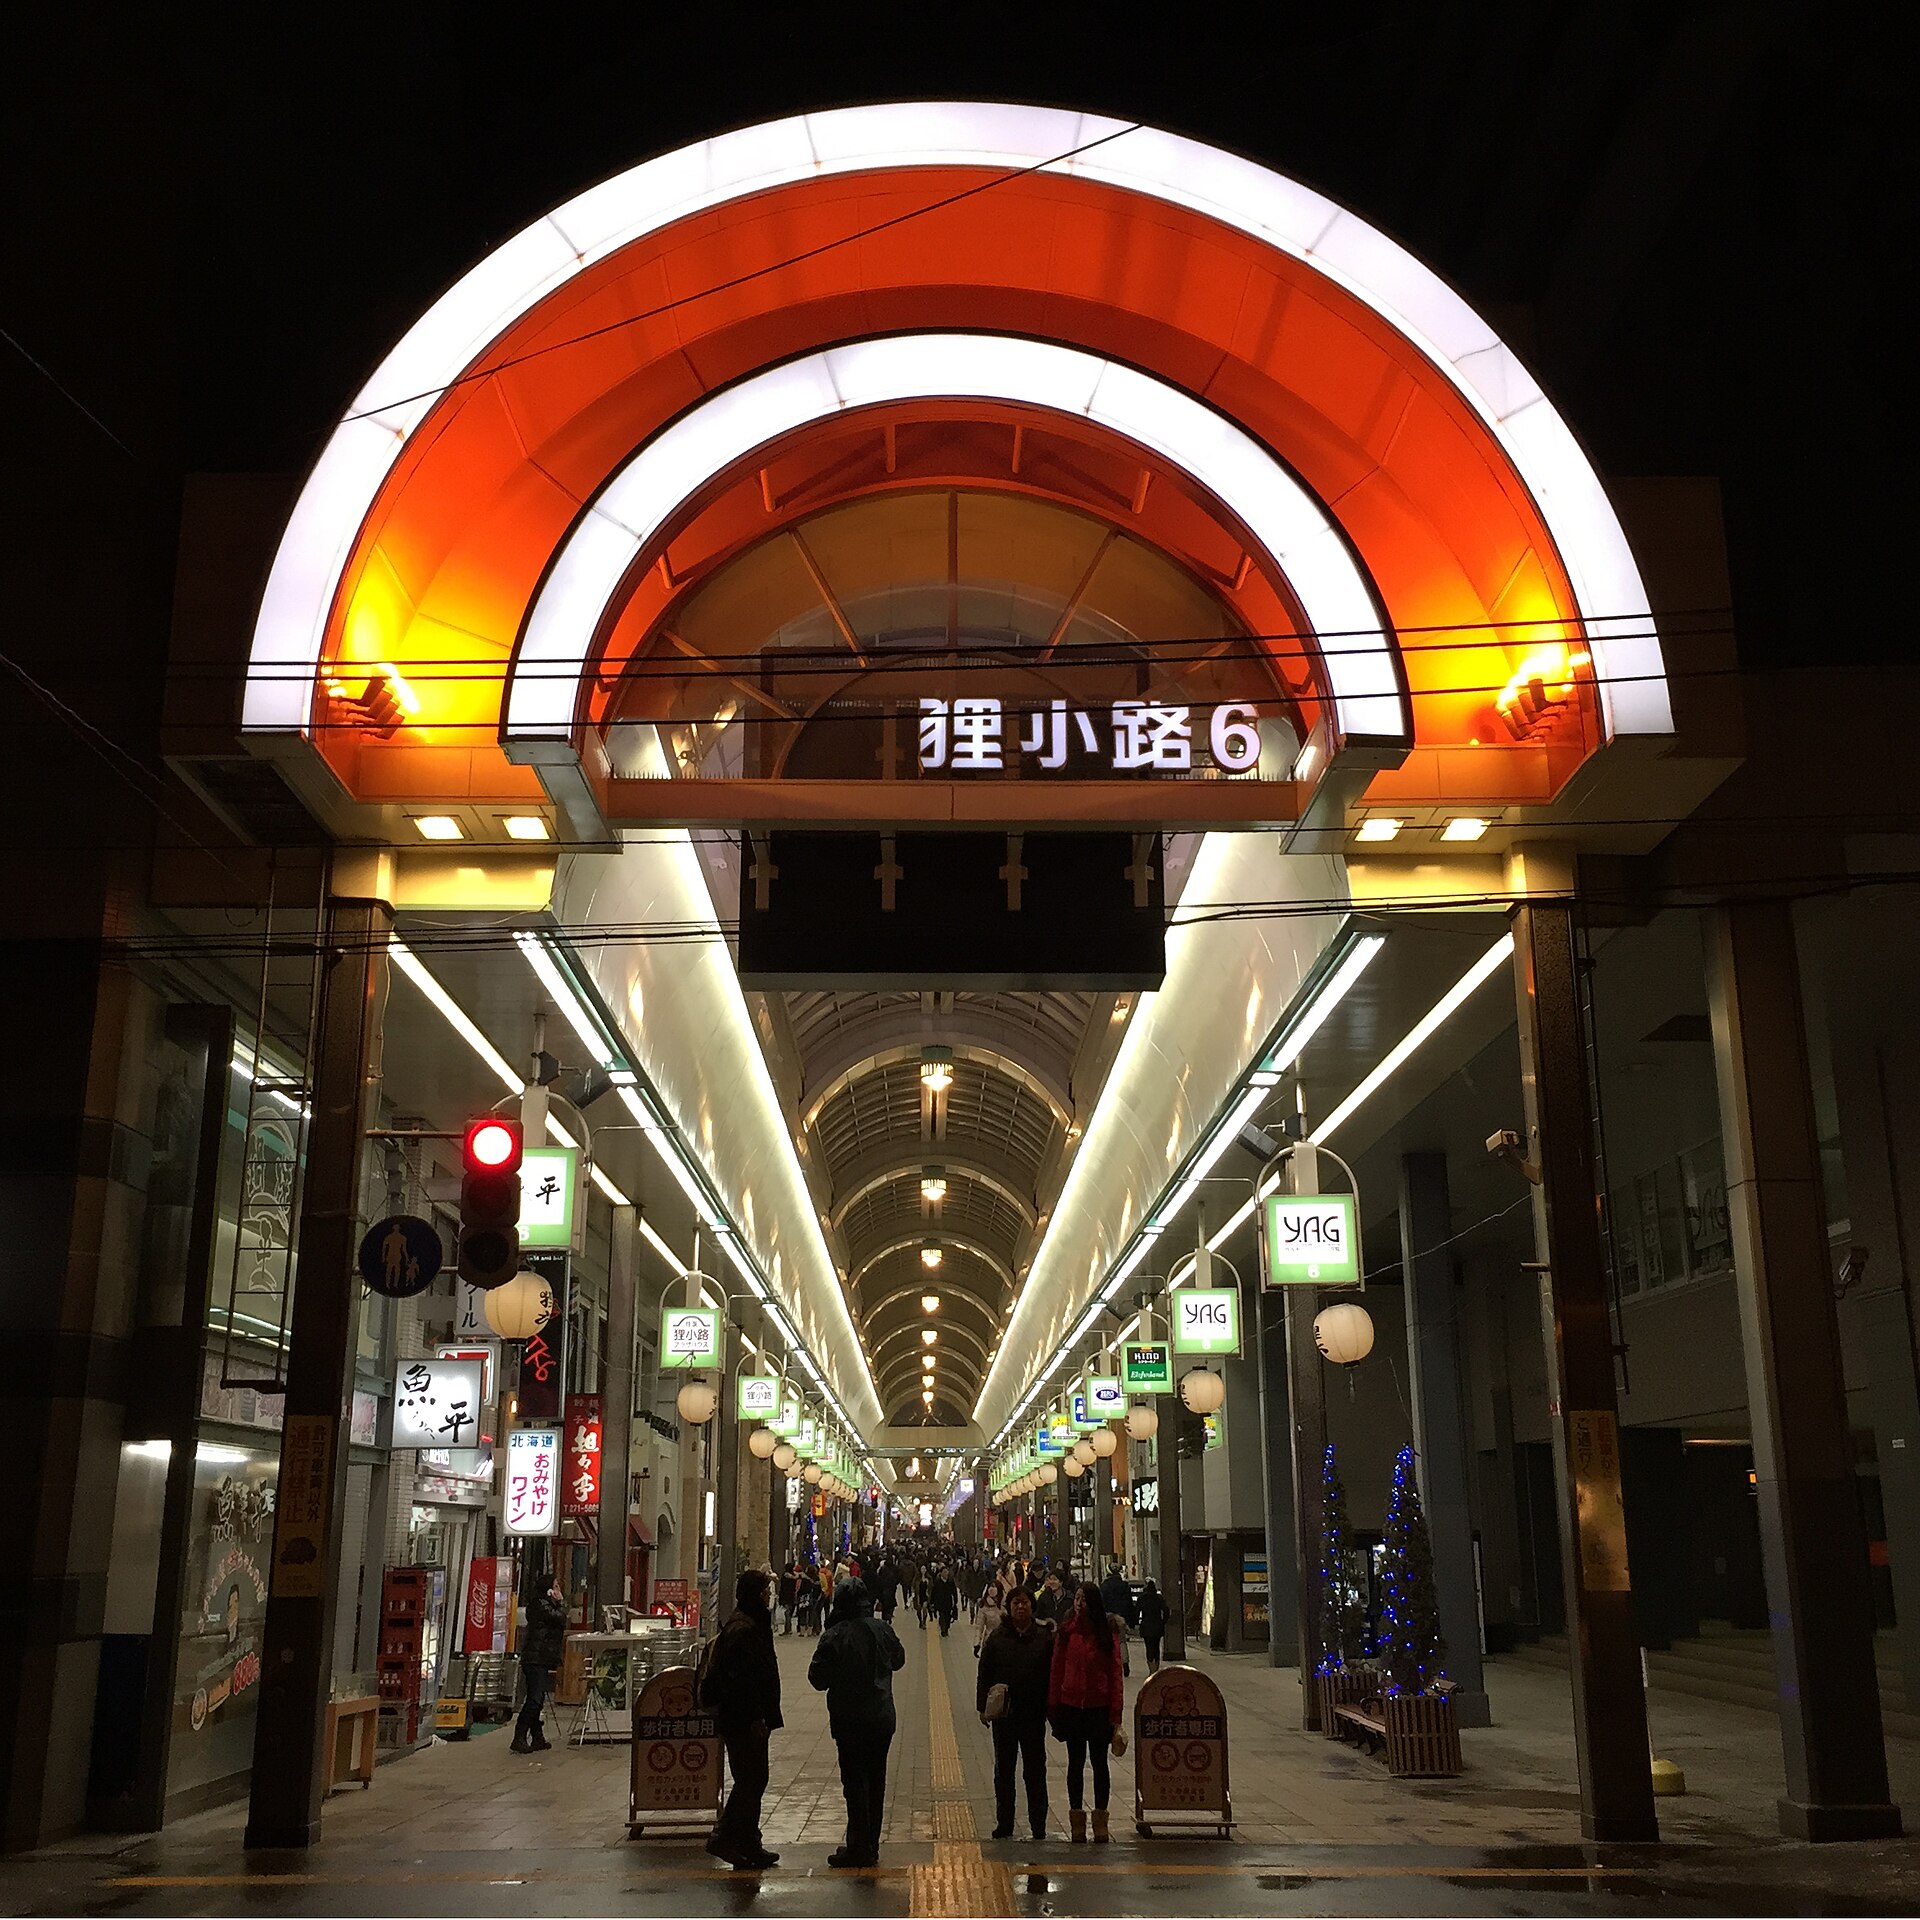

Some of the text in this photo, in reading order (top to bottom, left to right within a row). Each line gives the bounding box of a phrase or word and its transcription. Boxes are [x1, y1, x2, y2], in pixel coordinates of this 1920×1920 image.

[919, 698, 1262, 770] 狸小路6
[673, 1328, 710, 1341] 狸小路
[511, 1434, 554, 1448] 北海道
[510, 1475, 528, 1524] ワイン
[643, 1718, 715, 1737] 歩行者専用
[1145, 1719, 1217, 1737] 歩行者専用
